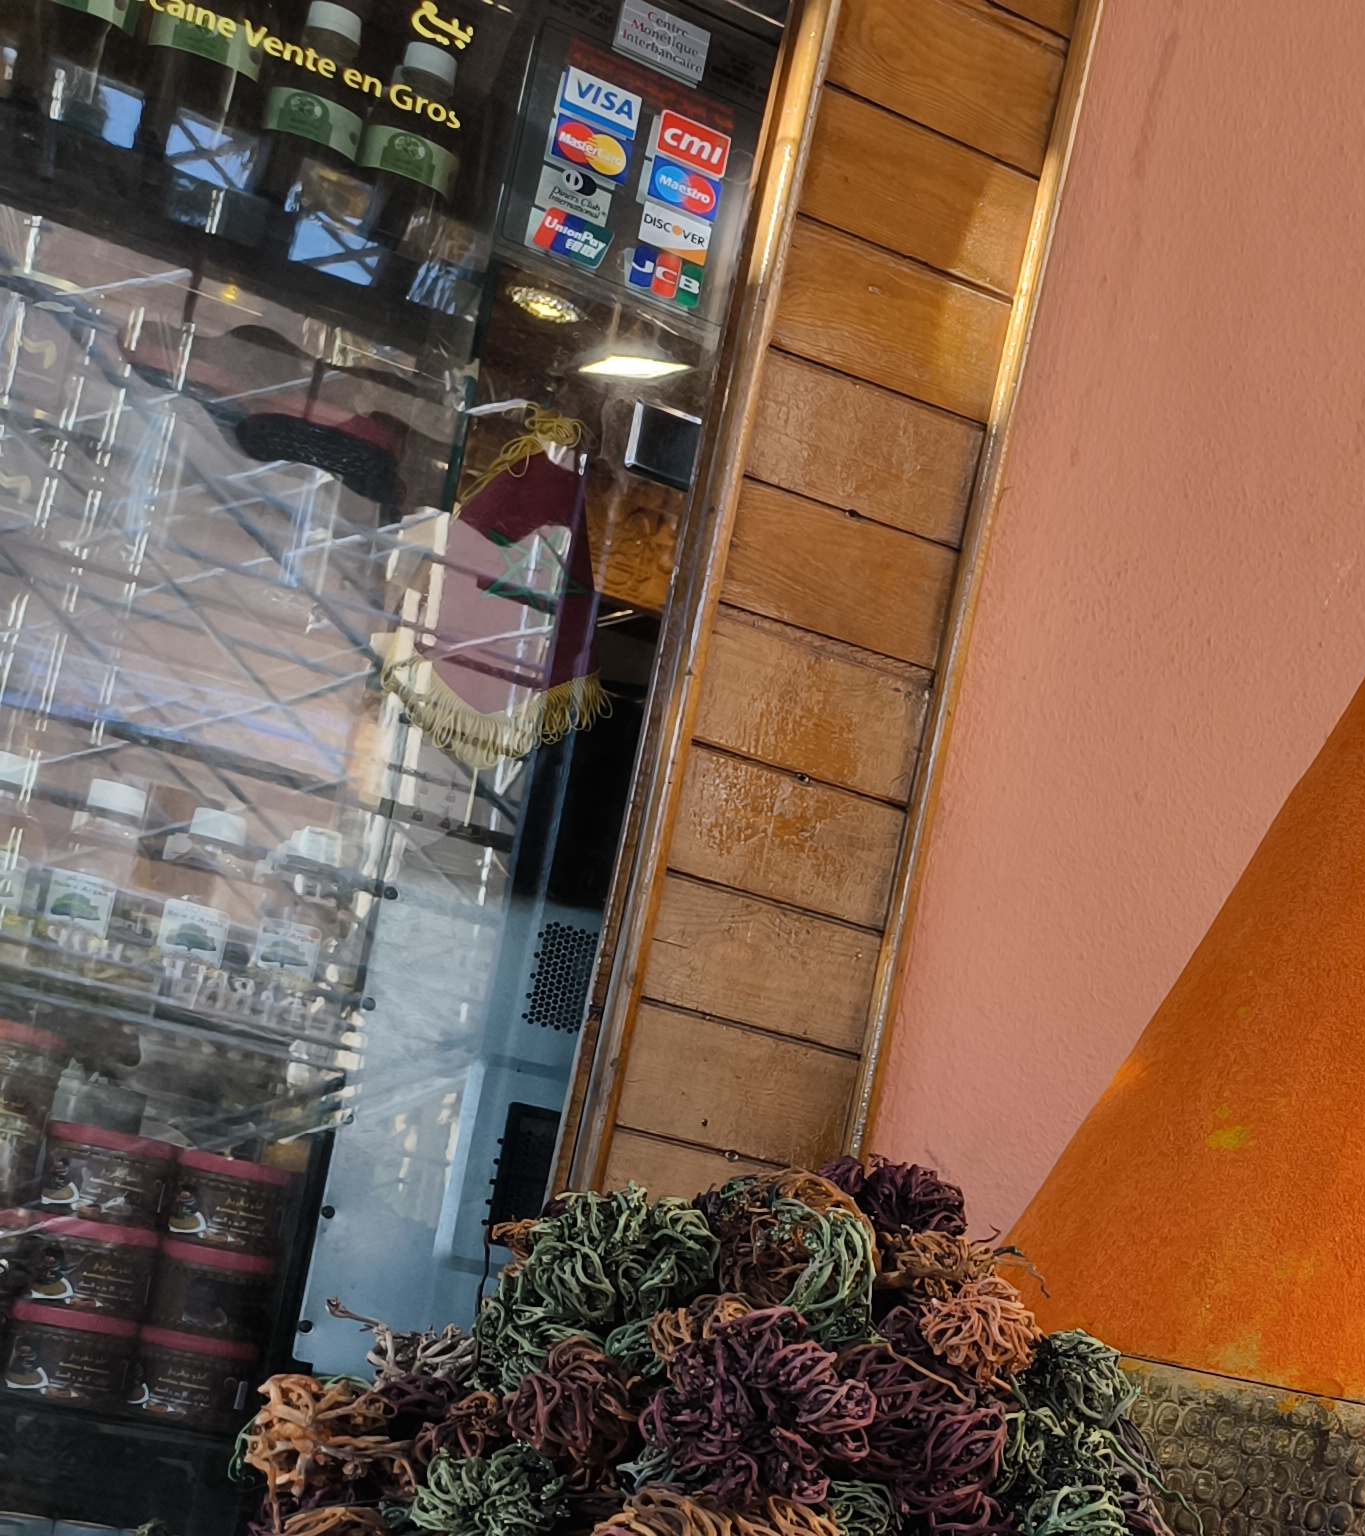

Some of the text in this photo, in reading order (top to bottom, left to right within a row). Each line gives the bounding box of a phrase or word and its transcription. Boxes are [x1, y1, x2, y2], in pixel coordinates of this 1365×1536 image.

[647, 11, 689, 37] Centre
[622, 28, 703, 74] Interbancaire
[244, 19, 337, 79] Vente
[342, 67, 383, 99] en
[389, 84, 462, 131] Gros
[576, 78, 634, 121] VISA
[558, 131, 626, 167] MasterCard
[663, 127, 724, 165] cmi
[659, 174, 711, 204] Maestro
[544, 216, 606, 251] UnionPay
[643, 212, 705, 247] DISCOVER
[631, 260, 700, 294] JCB
